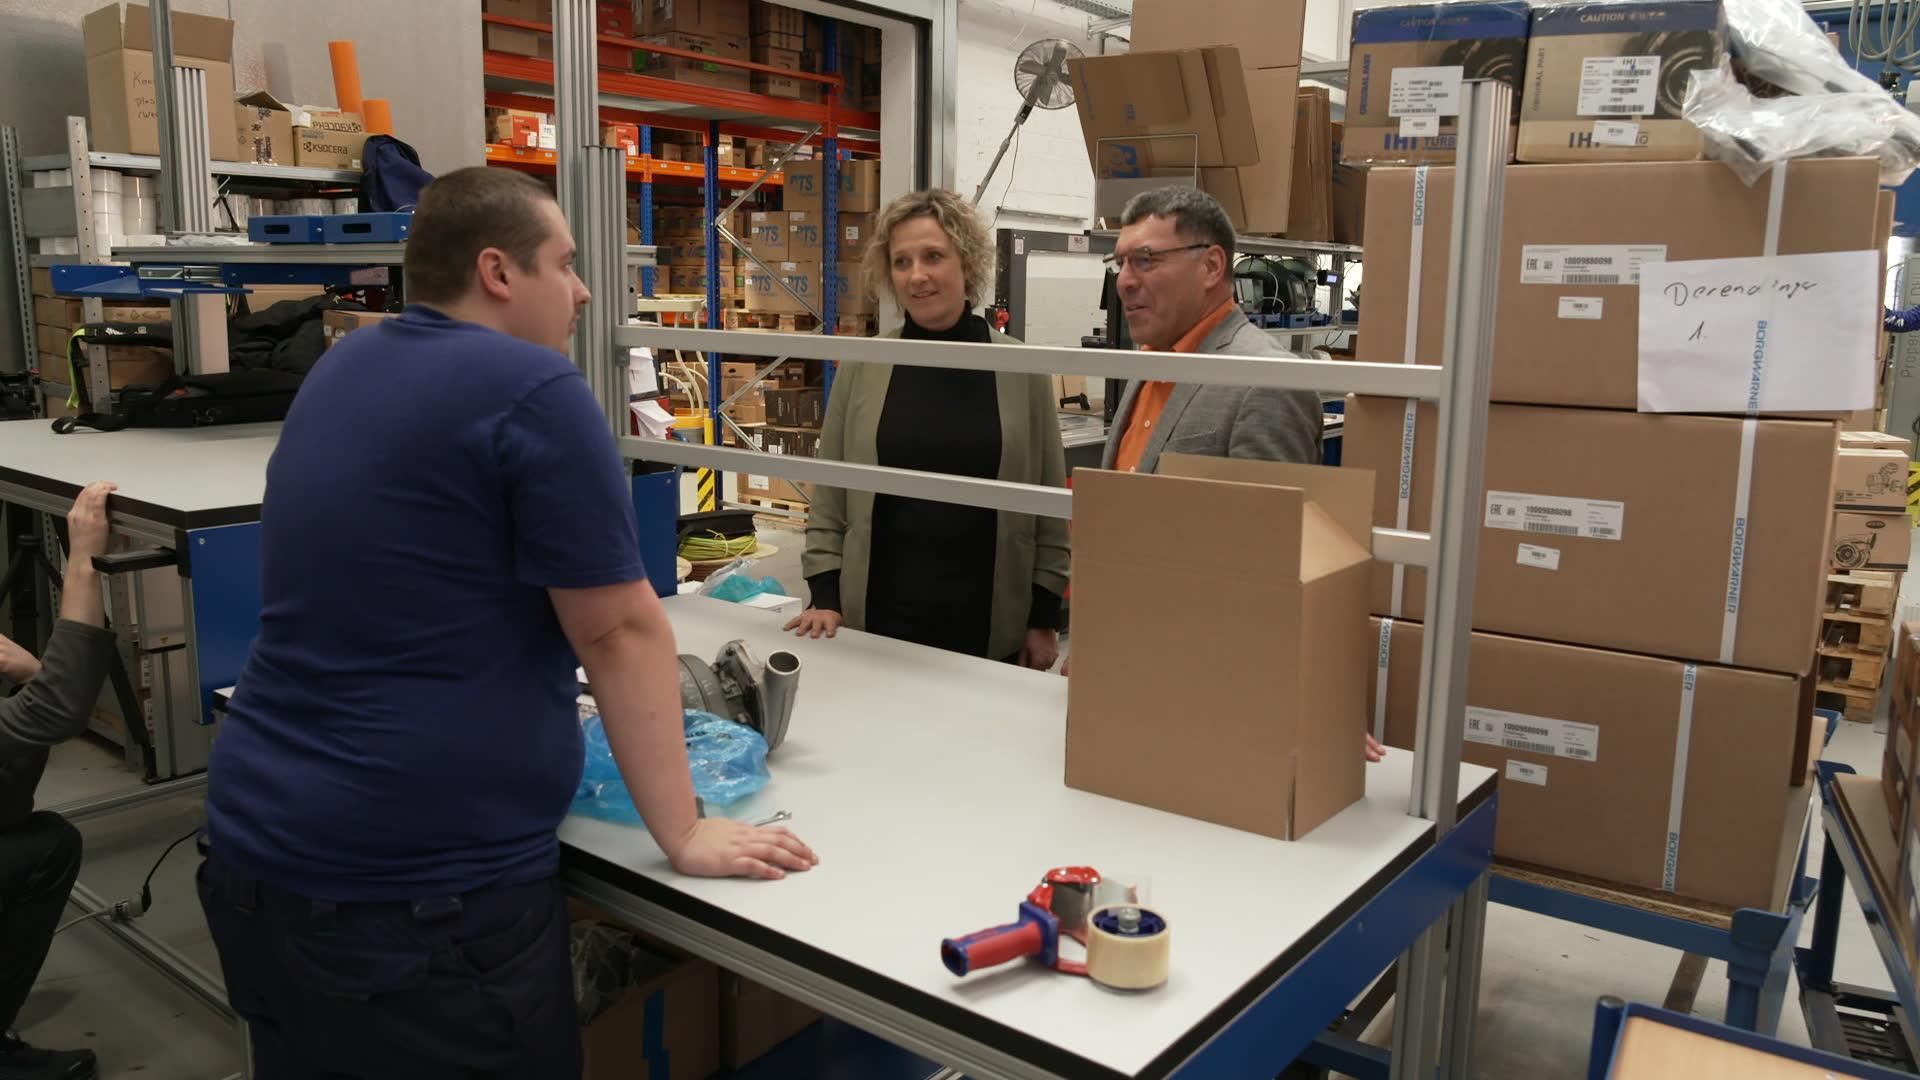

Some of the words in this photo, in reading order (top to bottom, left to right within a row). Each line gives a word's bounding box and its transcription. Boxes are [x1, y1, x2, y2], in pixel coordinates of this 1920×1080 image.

[1580, 13, 1625, 23] CAUTION
[1535, 47, 1544, 68] PART
[1384, 133, 1418, 150] IHI
[1423, 135, 1457, 148] TURB
[1568, 132, 1601, 148] IH
[1414, 170, 1425, 226] BORGWA
[1748, 320, 1767, 409] BORGWARNE
[1401, 412, 1415, 499] BORGWARNER
[1727, 517, 1746, 614] BORGWARNER
